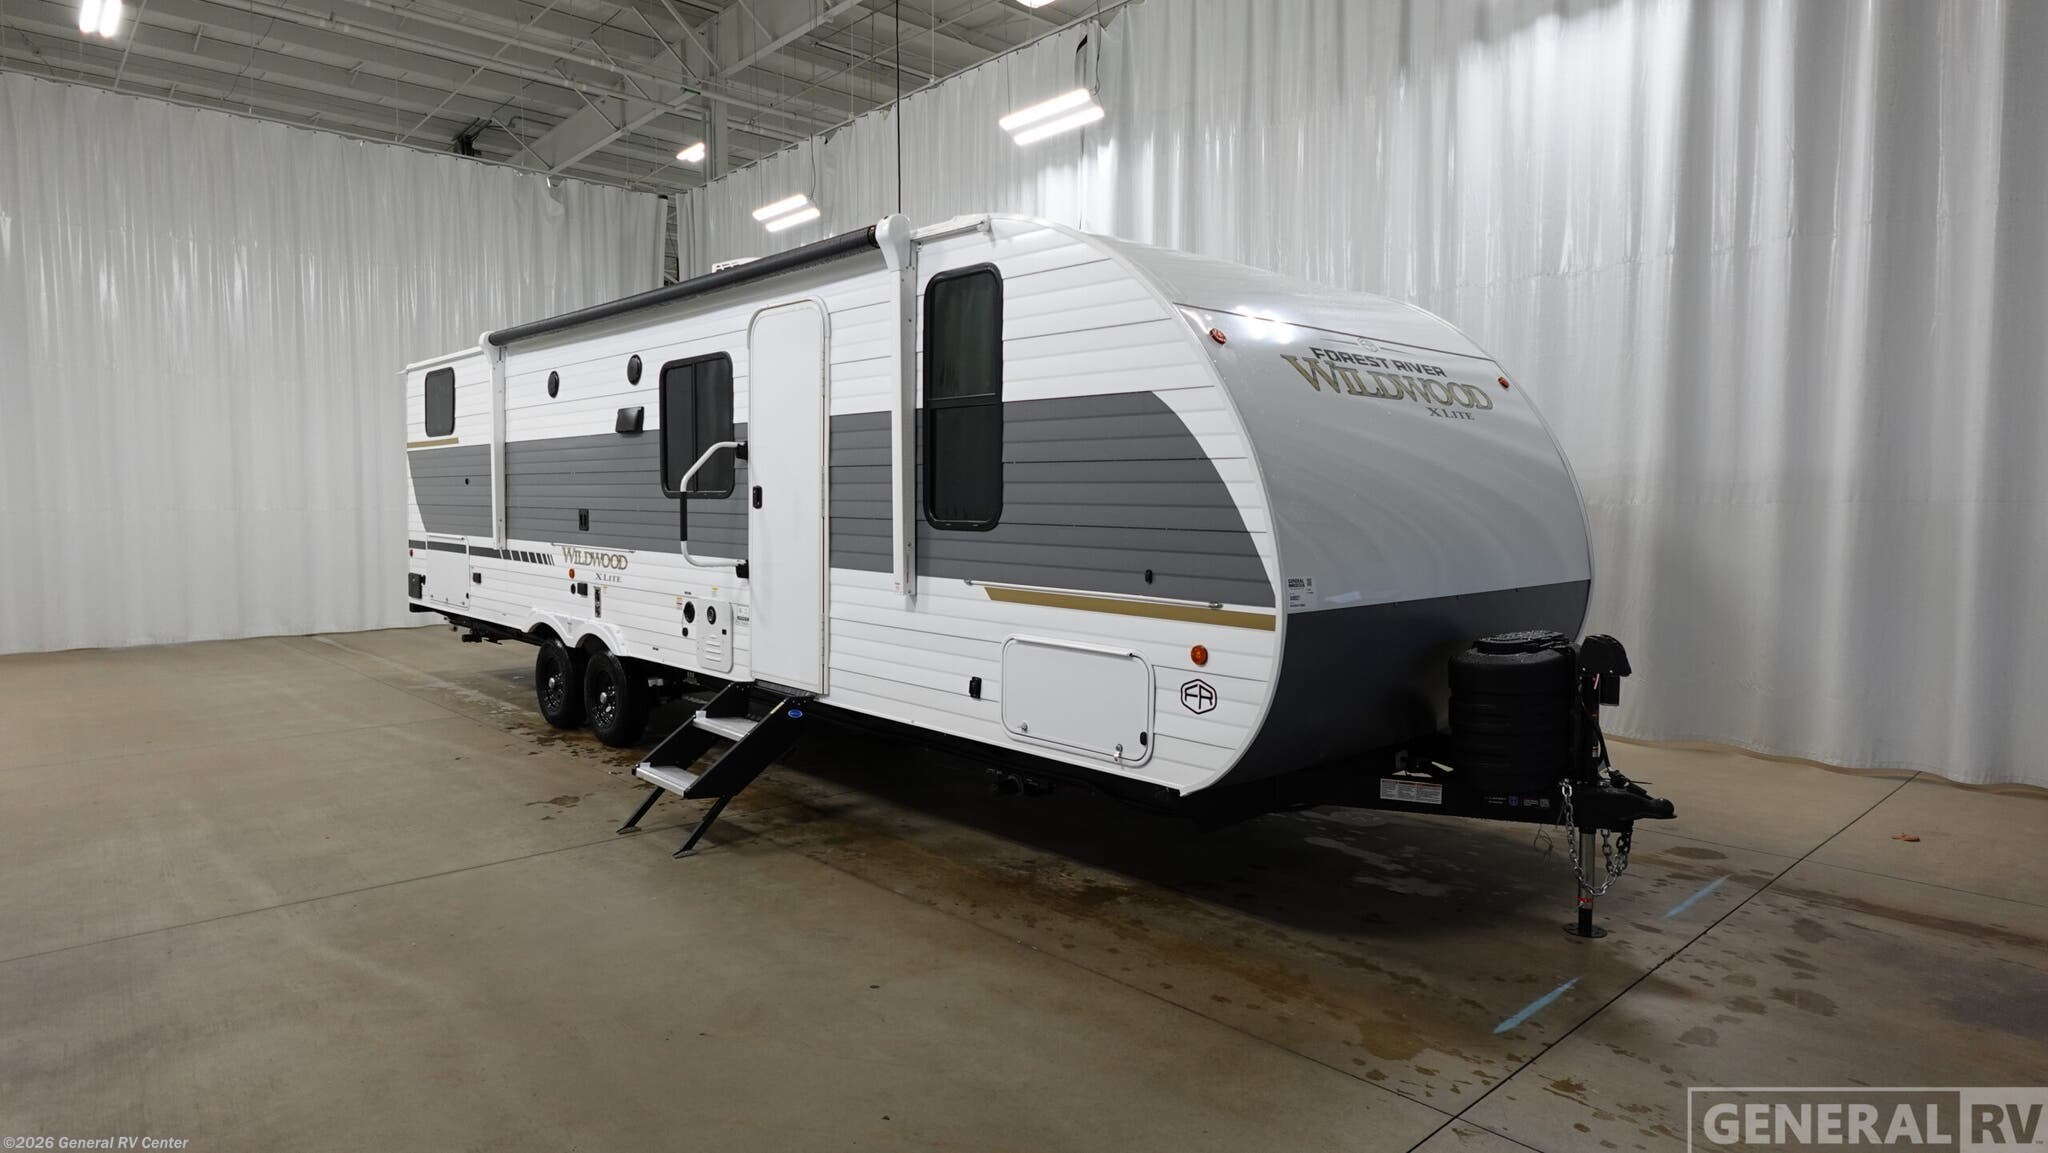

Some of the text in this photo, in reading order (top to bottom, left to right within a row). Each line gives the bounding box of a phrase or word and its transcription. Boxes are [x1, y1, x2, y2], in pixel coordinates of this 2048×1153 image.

[1309, 347, 1447, 377] FOREST RIVER
[1280, 354, 1493, 410] WILDWOOD
[562, 546, 628, 570] WILDWOOD
[1184, 684, 1213, 709] FR
